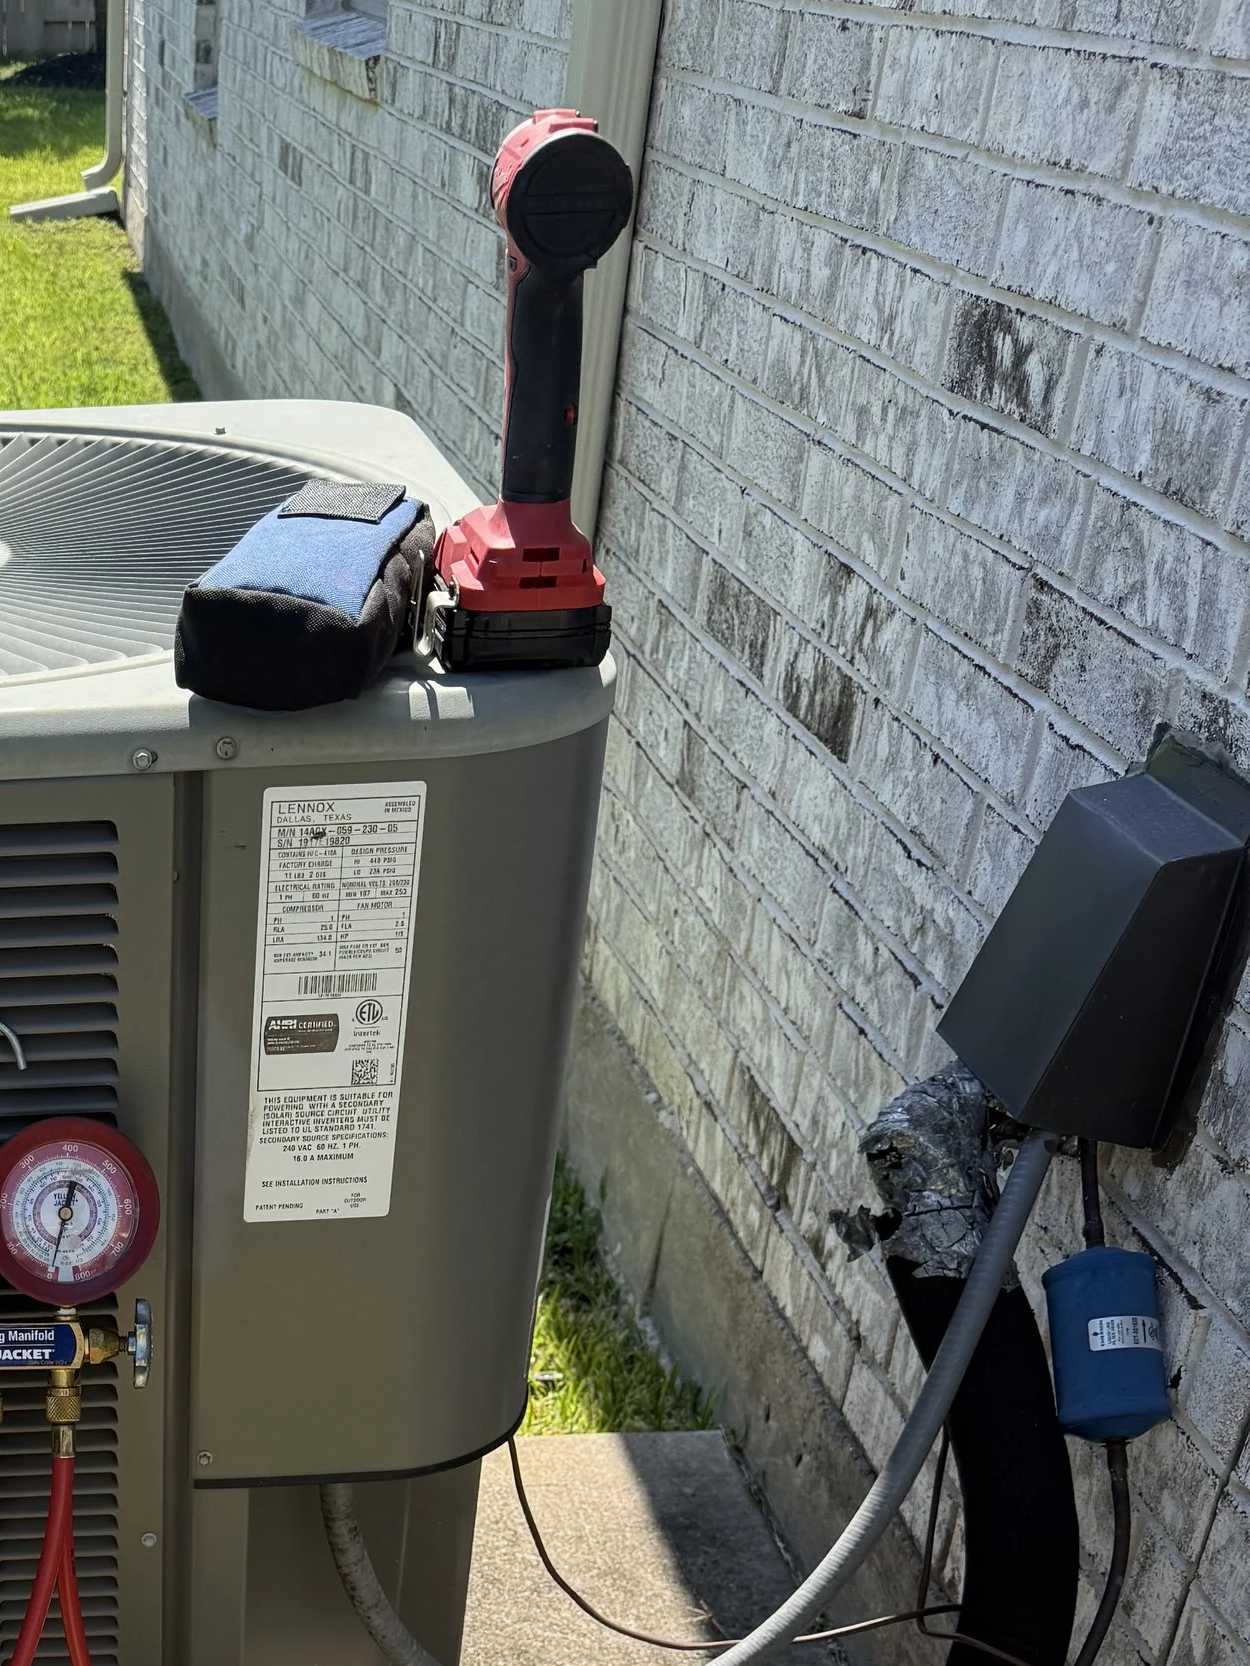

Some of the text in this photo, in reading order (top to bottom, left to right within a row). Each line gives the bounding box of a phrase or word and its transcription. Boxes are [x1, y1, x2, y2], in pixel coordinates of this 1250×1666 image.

[278, 802, 335, 815] LENNOX
[277, 813, 352, 824] DALLAS, TEXAS
[277, 828, 296, 838] M/N
[277, 838, 293, 848] S/N
[375, 846, 408, 854] PRESSURE
[279, 861, 306, 869] FACTORY
[275, 882, 335, 892] ELECTRICAL RATING
[282, 904, 324, 913] COMPRESSOR
[357, 901, 393, 910] FAN MOTOR
[298, 1020, 334, 1029] CERTIFIED
[353, 1029, 381, 1037] Intertek
[264, 1096, 281, 1104] THIS
[283, 1094, 327, 1103] EQUIPMENT
[339, 1092, 375, 1100] SUITABLE
[378, 1091, 393, 1099] FOR
[263, 1103, 304, 1111] POWERING
[309, 1102, 328, 1110] WITH
[338, 1100, 384, 1108] SECONDARY
[263, 1111, 293, 1120] (SOLAR)
[295, 1110, 325, 1118] SOURCE
[362, 1107, 391, 1115] UTILITY
[262, 1114, 390, 1127] INTERACTIVE INVERTERS MUST BE
[262, 1127, 288, 1135] LISTED
[291, 1126, 300, 1134] TO
[314, 1124, 355, 1133] STANDARD
[259, 1131, 389, 1144] SECONDARY SOURCE SPECIFICATIONS:
[62, 1144, 79, 1152] 400
[283, 1144, 296, 1152] 240
[20, 1155, 35, 1169] 300
[317, 1153, 354, 1161] MAXIMUM
[102, 1159, 117, 1174] 500
[262, 1176, 368, 1188] SEE INSTALLATION INSTRUCTIONS
[0, 1193, 8, 1210] 200
[123, 1198, 132, 1215] 600
[255, 1202, 303, 1211] PATENT PENDING
[6, 1241, 18, 1255] 100
[110, 1241, 124, 1257] 700
[46, 1272, 53, 1280] 0
[74, 1270, 91, 1281] 800
[8, 1330, 55, 1341] Manifold
